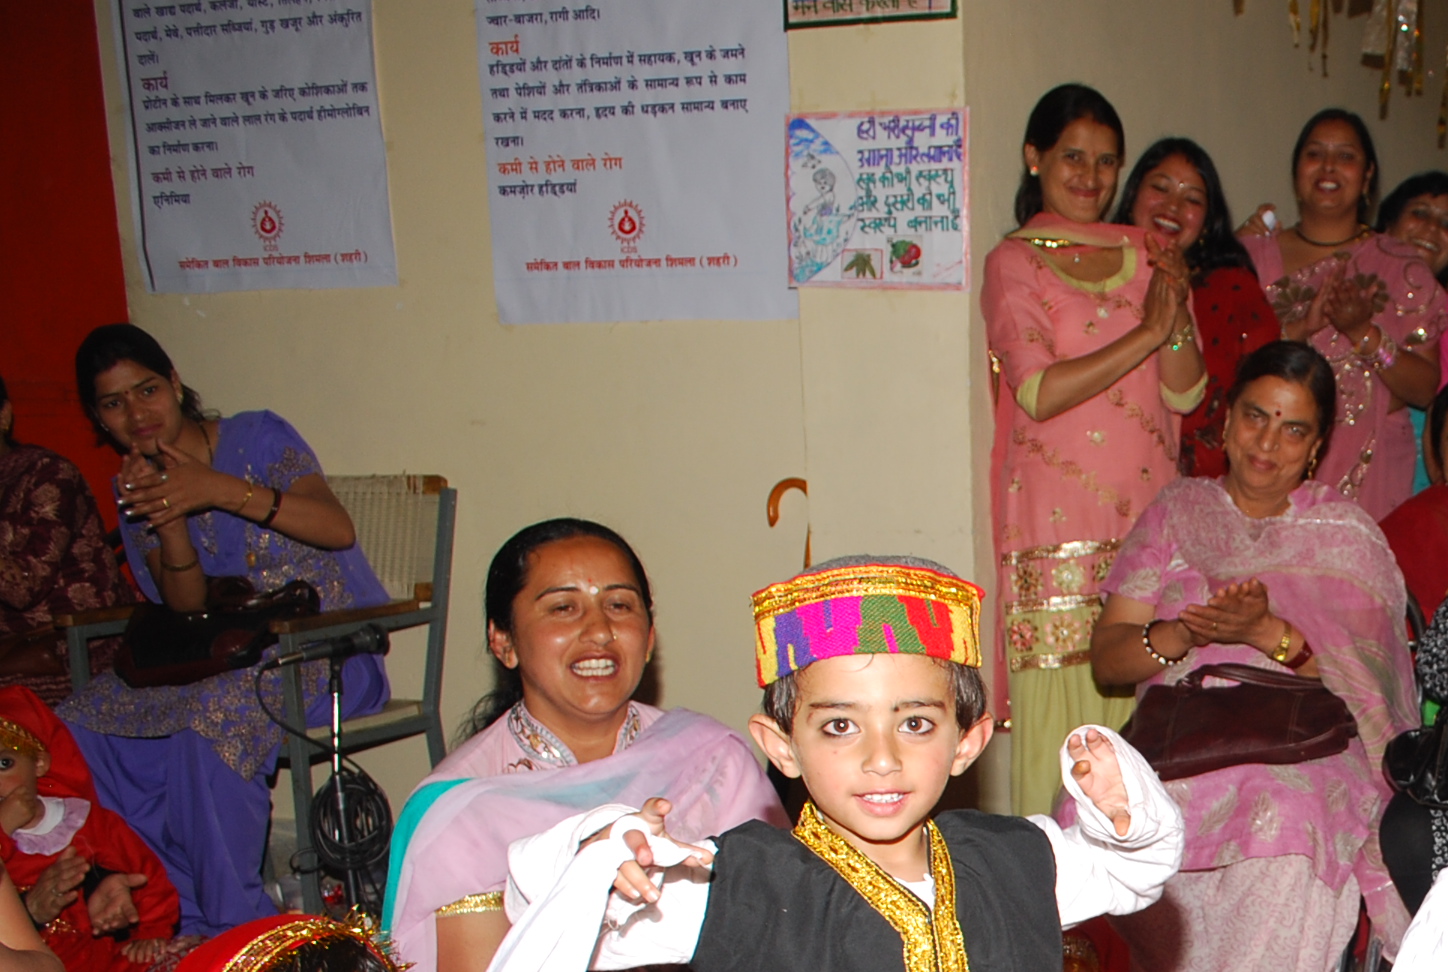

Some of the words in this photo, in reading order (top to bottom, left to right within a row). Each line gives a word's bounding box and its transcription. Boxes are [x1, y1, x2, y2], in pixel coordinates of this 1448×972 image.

[132, 3, 151, 18] वाले
[154, 5, 176, 17] खाद्य
[279, 17, 303, 32] खजूर
[307, 10, 323, 26] और
[328, 8, 362, 28] अंकुरित
[549, 6, 570, 22] रागी
[488, 33, 520, 56] कार्य
[530, 56, 548, 72] और
[551, 54, 573, 71] दांतों
[576, 54, 587, 69] के
[590, 52, 623, 68] निर्माण
[626, 50, 635, 66] में
[638, 51, 681, 66] सहायक,
[683, 50, 702, 67] खून
[705, 44, 716, 61] के
[719, 43, 745, 60] जमने
[141, 70, 169, 92] कार्य
[490, 87, 510, 100] तथा
[515, 81, 546, 98] पेशियों
[553, 79, 571, 96] और
[576, 75, 622, 94] तंत्रिकाओं
[627, 75, 638, 91] के
[644, 77, 679, 91] सामान्य
[684, 75, 703, 88] रूप
[708, 70, 718, 86] से
[723, 73, 747, 85] काम
[169, 93, 180, 108] के
[182, 96, 201, 109] साथ
[204, 91, 237, 106] मिलकर
[239, 91, 256, 107] खून
[258, 86, 269, 100] के
[298, 79, 348, 98] कोशिकाओं
[351, 81, 369, 94] तक
[146, 117, 187, 133] आक्सीजन
[188, 115, 198, 130] ले
[198, 113, 218, 129] जाने
[219, 111, 240, 127] वाले
[241, 113, 262, 127] लाल
[264, 110, 277, 124] रंग
[278, 107, 288, 123] के
[290, 105, 314, 122] पदार्थ
[316, 102, 371, 122] हीमोग्लोबिन
[492, 107, 516, 123] करने
[520, 106, 528, 121] में
[532, 109, 554, 121] मदद
[559, 107, 590, 121] करना,
[620, 100, 635, 116] की
[680, 100, 715, 113] सामान्य
[147, 145, 161, 156] का
[162, 140, 190, 155] निर्माण
[151, 168, 173, 184] कमी
[176, 165, 186, 183] से
[189, 164, 208, 184] होने
[210, 162, 233, 179] वाले
[236, 161, 255, 178] रोग
[497, 157, 522, 175] कमी
[528, 156, 539, 174] से
[544, 154, 566, 175] होने
[571, 152, 596, 171] वाले
[602, 151, 623, 170] रोग
[262, 252, 300, 267] परियोजना
[525, 258, 559, 273] समेकित
[562, 259, 581, 271] बाल
[585, 256, 615, 271] विकास
[619, 254, 662, 269] परियोजना
[665, 254, 696, 268] शिमला
